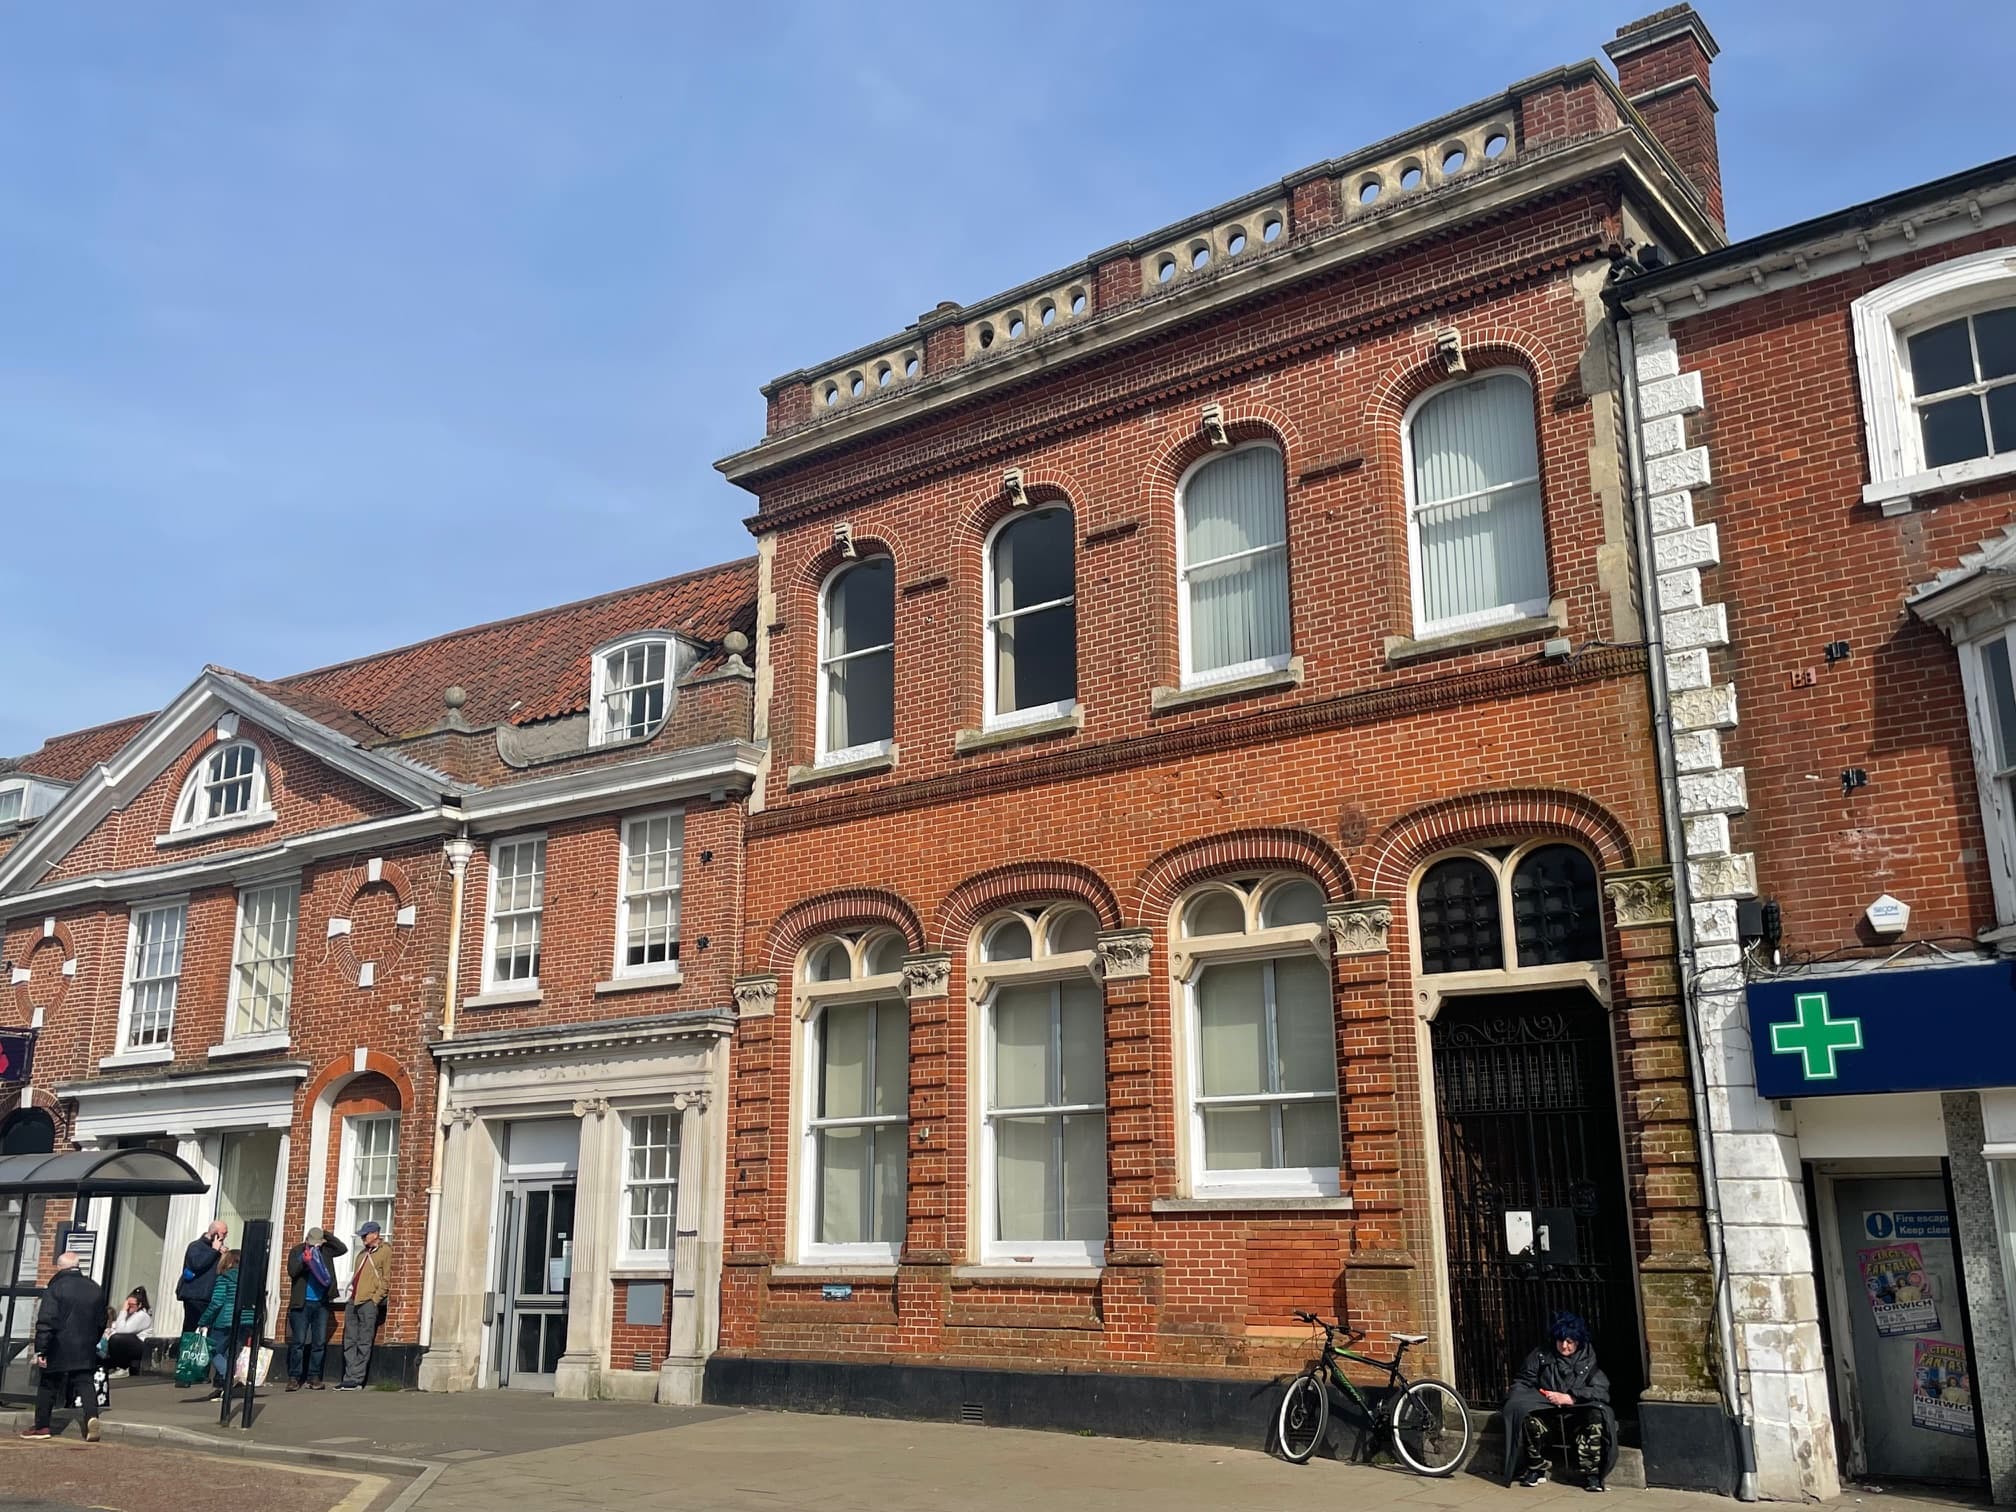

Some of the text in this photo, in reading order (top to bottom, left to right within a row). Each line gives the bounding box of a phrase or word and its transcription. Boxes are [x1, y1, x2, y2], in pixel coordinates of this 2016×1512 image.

[1896, 1214, 1914, 1222] Fire
[1900, 1226, 1924, 1236] Keep
[1874, 1299, 1932, 1313] NORWICH
